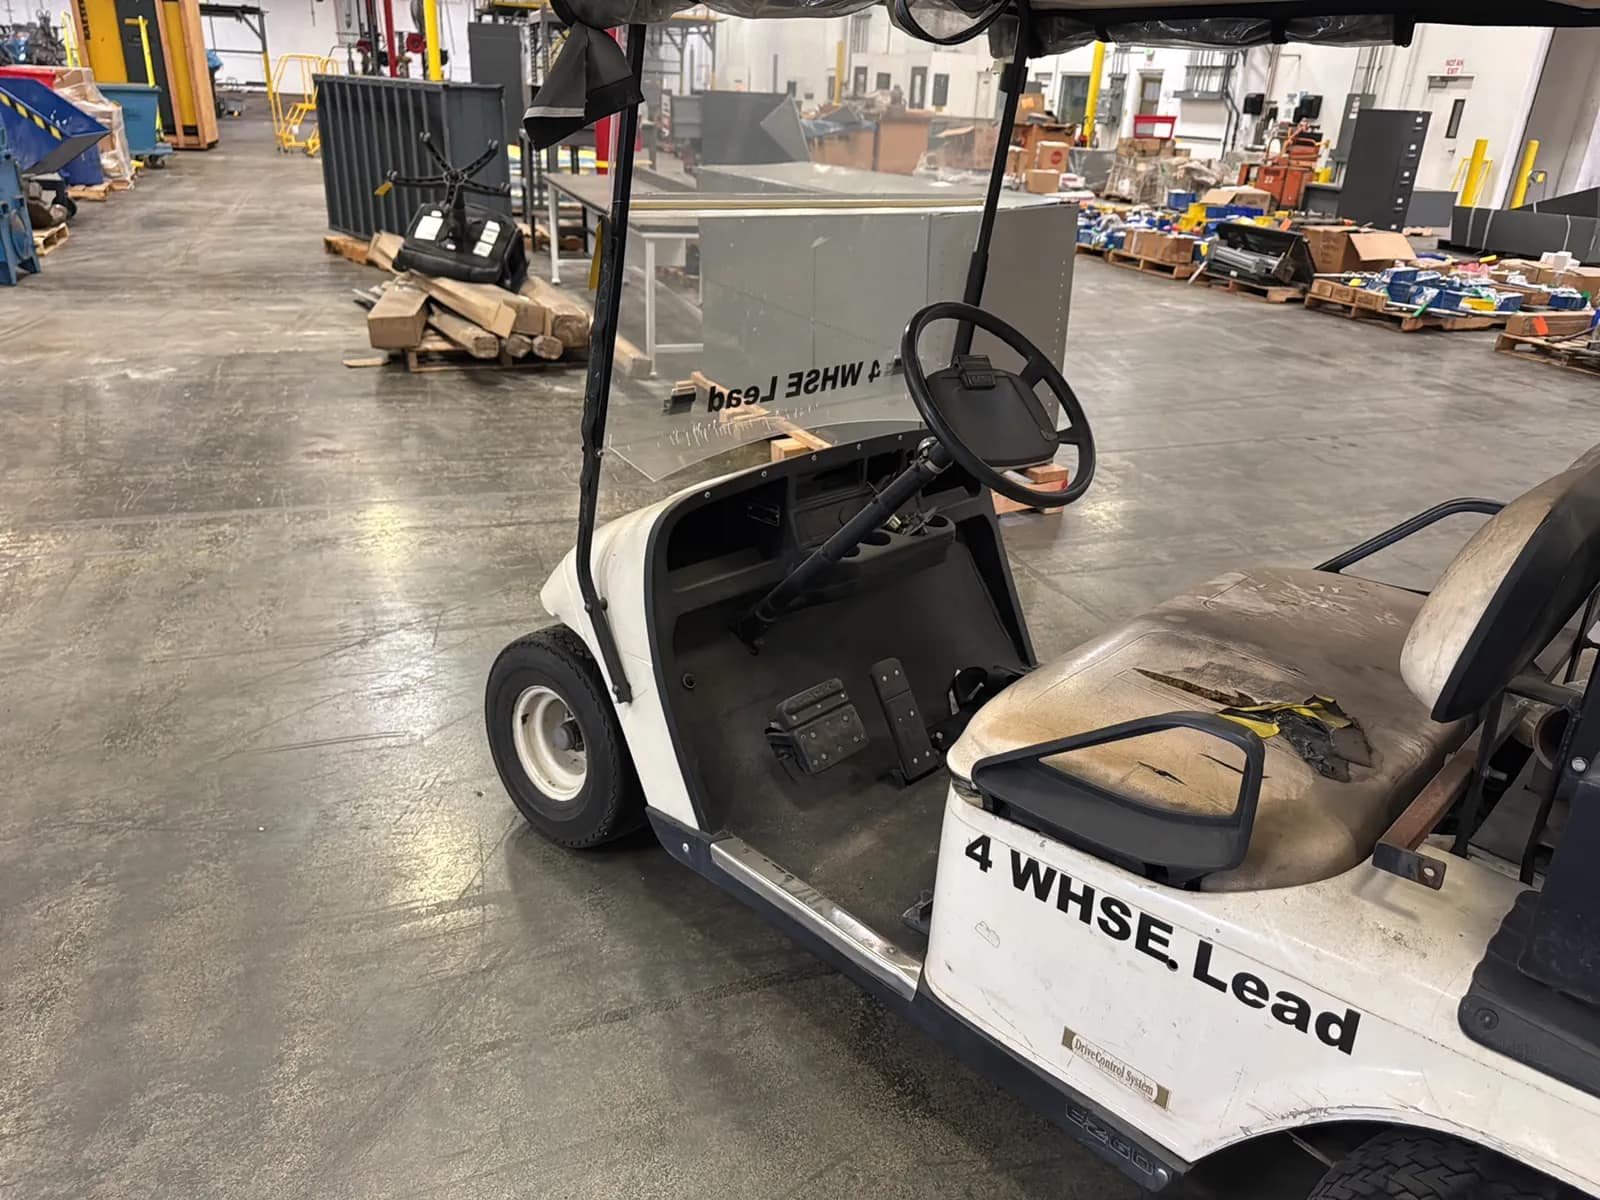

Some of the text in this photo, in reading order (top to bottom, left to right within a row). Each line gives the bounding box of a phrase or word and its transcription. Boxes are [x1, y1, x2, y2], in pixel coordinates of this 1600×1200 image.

[965, 834, 992, 872] 4
[1193, 939, 1362, 1055] Lead
[1074, 1038, 1154, 1097] DriveControl System
